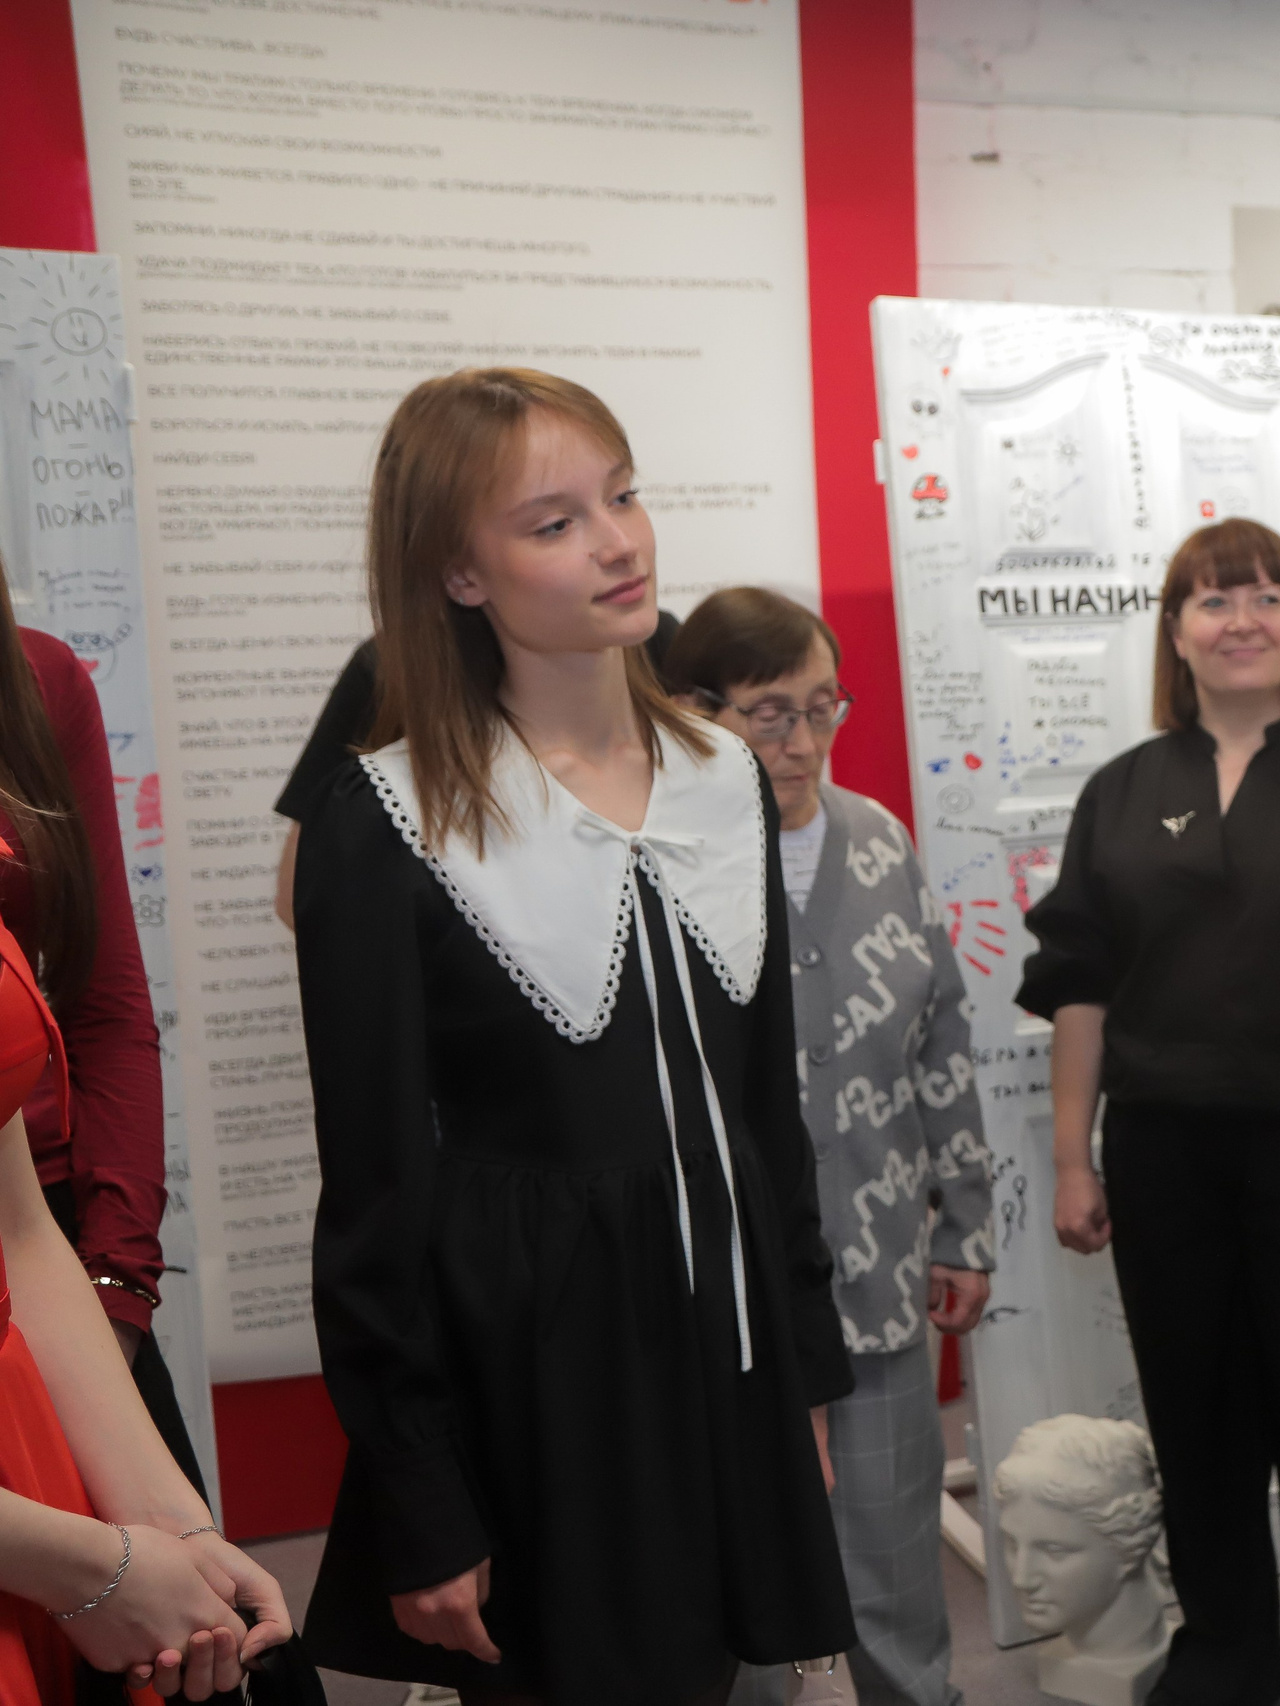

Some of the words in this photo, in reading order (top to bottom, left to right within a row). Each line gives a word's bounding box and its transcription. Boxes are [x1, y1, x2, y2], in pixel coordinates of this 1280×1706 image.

[30, 398, 121, 439] МАМА
[33, 454, 126, 484] ОГОНЬ
[978, 586, 1040, 616] МЫ
